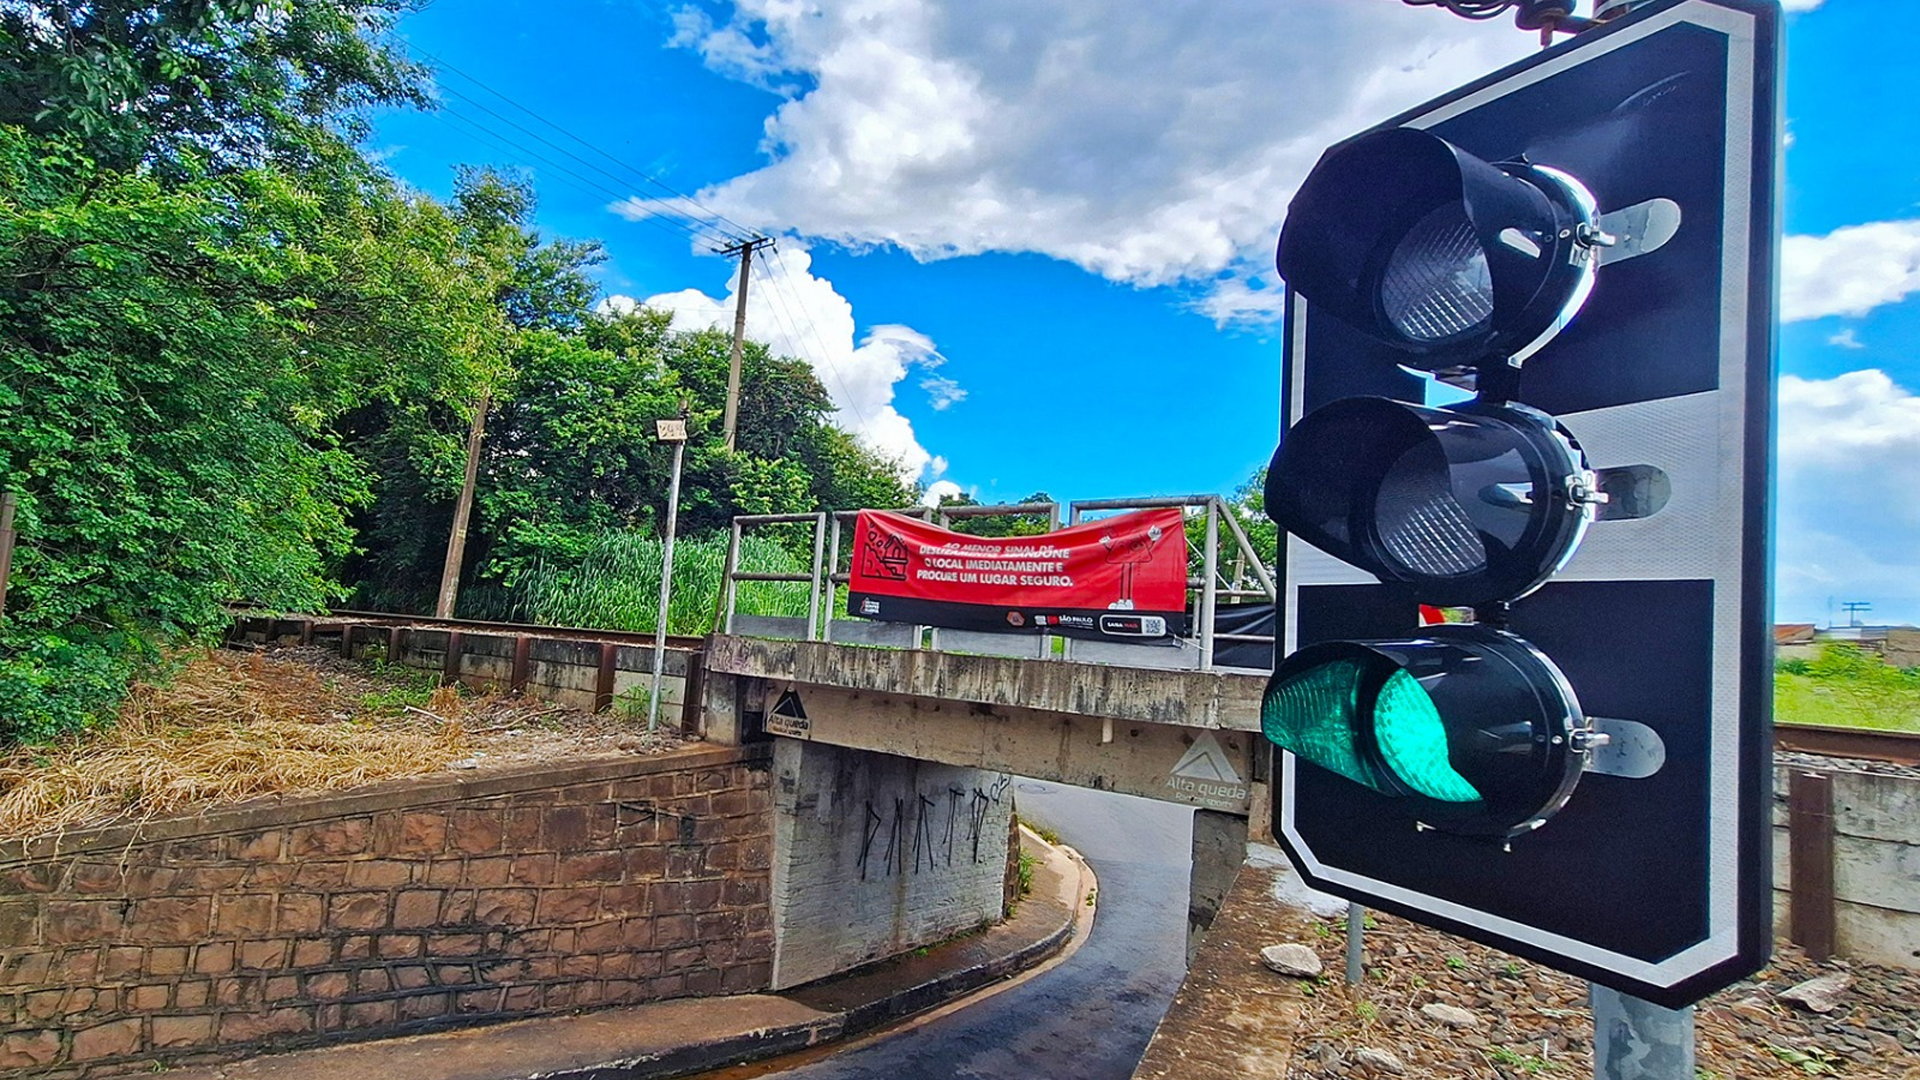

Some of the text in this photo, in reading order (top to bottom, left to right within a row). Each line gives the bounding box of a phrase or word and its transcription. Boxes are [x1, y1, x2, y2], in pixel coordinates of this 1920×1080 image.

[961, 544, 1002, 553] MENOR
[1005, 545, 1035, 554] SINAL
[925, 557, 1064, 572] O LOCAL IMEDIATAMENTE E
[917, 569, 1074, 587] PROCURE UM LUGAR SEGURO.
[769, 714, 809, 730] Alta queda
[1166, 776, 1247, 800] Alta queda
[1206, 798, 1234, 808] sports
